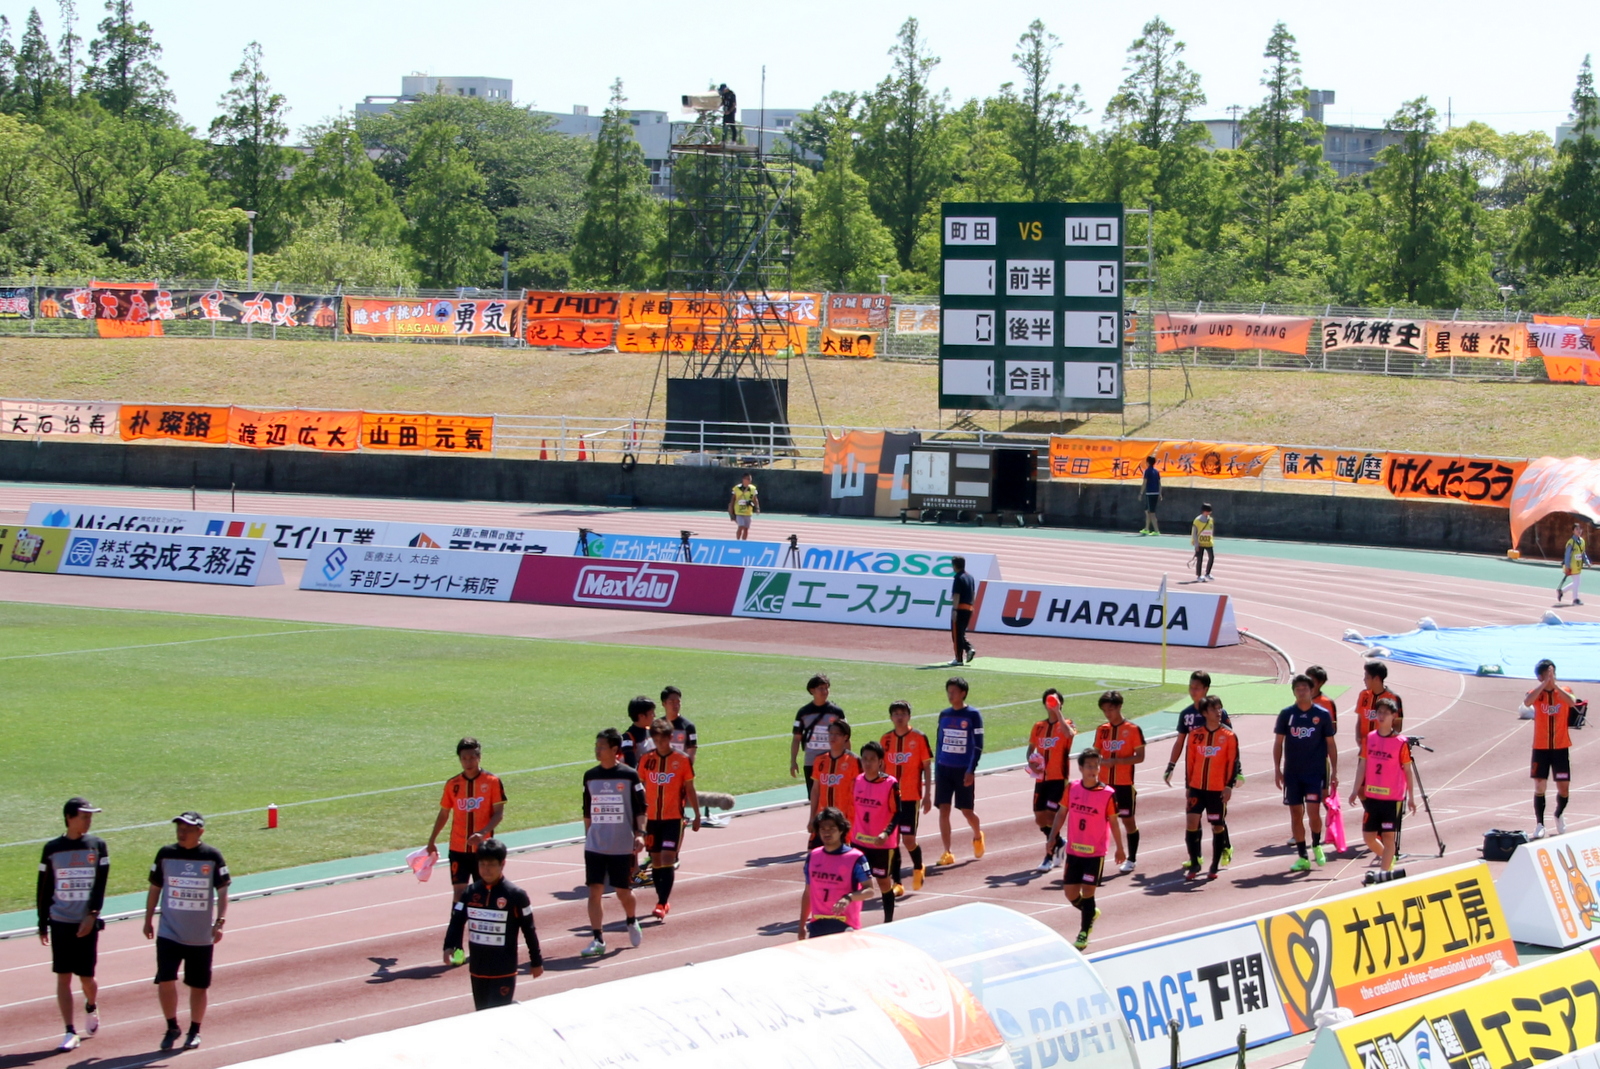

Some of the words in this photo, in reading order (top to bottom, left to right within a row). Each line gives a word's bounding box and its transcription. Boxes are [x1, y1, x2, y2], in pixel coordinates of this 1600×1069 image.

[951, 221, 990, 240] 町田
[1018, 221, 1042, 241] VS
[1072, 222, 1112, 242] 山口
[1009, 266, 1052, 290] 前半
[1098, 265, 1114, 293] 0
[528, 296, 618, 314] ケンタロウ
[640, 300, 673, 316] 岸田
[453, 302, 509, 333] 勇気
[398, 324, 448, 334] KAGAWA
[976, 314, 992, 342] 0
[1008, 317, 1052, 341] 後半
[1098, 316, 1114, 344] 0
[1209, 324, 1234, 337] UND
[1246, 324, 1287, 339] DRANG
[822, 337, 854, 354] 大樹
[1435, 331, 1510, 356] 星雄次
[1526, 332, 1556, 348] 香川
[1560, 333, 1596, 351] 勇気
[1008, 366, 1050, 391] 合計
[1098, 366, 1114, 394] 0
[13, 414, 105, 434] 大石治寿
[370, 425, 484, 450] 山田元気
[1054, 455, 1091, 475] 岸田
[1388, 458, 1514, 500] けんたろう
[99, 538, 132, 554] 株式
[95, 554, 126, 569] 会社
[128, 542, 257, 577] 安成工務店
[364, 550, 402, 564] 医療法人
[410, 553, 440, 566] 太白会
[350, 570, 498, 596] 宇部シーサイド病院
[583, 568, 668, 600] MaxValu
[744, 594, 784, 613] ACE
[1047, 598, 1188, 631] HARADA
[1184, 714, 1194, 725] 33
[1540, 704, 1562, 716] upr
[1290, 726, 1316, 738] upr
[1038, 736, 1059, 749] upr
[1102, 740, 1125, 752] upr
[1197, 746, 1222, 757] upr
[888, 752, 912, 764] upr
[650, 772, 675, 785] upr
[1376, 764, 1382, 774] 2
[820, 773, 844, 786] upr
[457, 797, 484, 811] upr
[863, 811, 870, 824] 4
[1078, 818, 1086, 831] 6
[1344, 878, 1495, 976] オカダ工房
[1360, 986, 1373, 1000] the
[1374, 979, 1402, 996] creation
[1409, 960, 1467, 986] three-dimensional
[1466, 956, 1484, 970] urban
[1484, 950, 1502, 967] space
[1116, 970, 1204, 1042] RACE
[1196, 952, 1268, 1022] 下関
